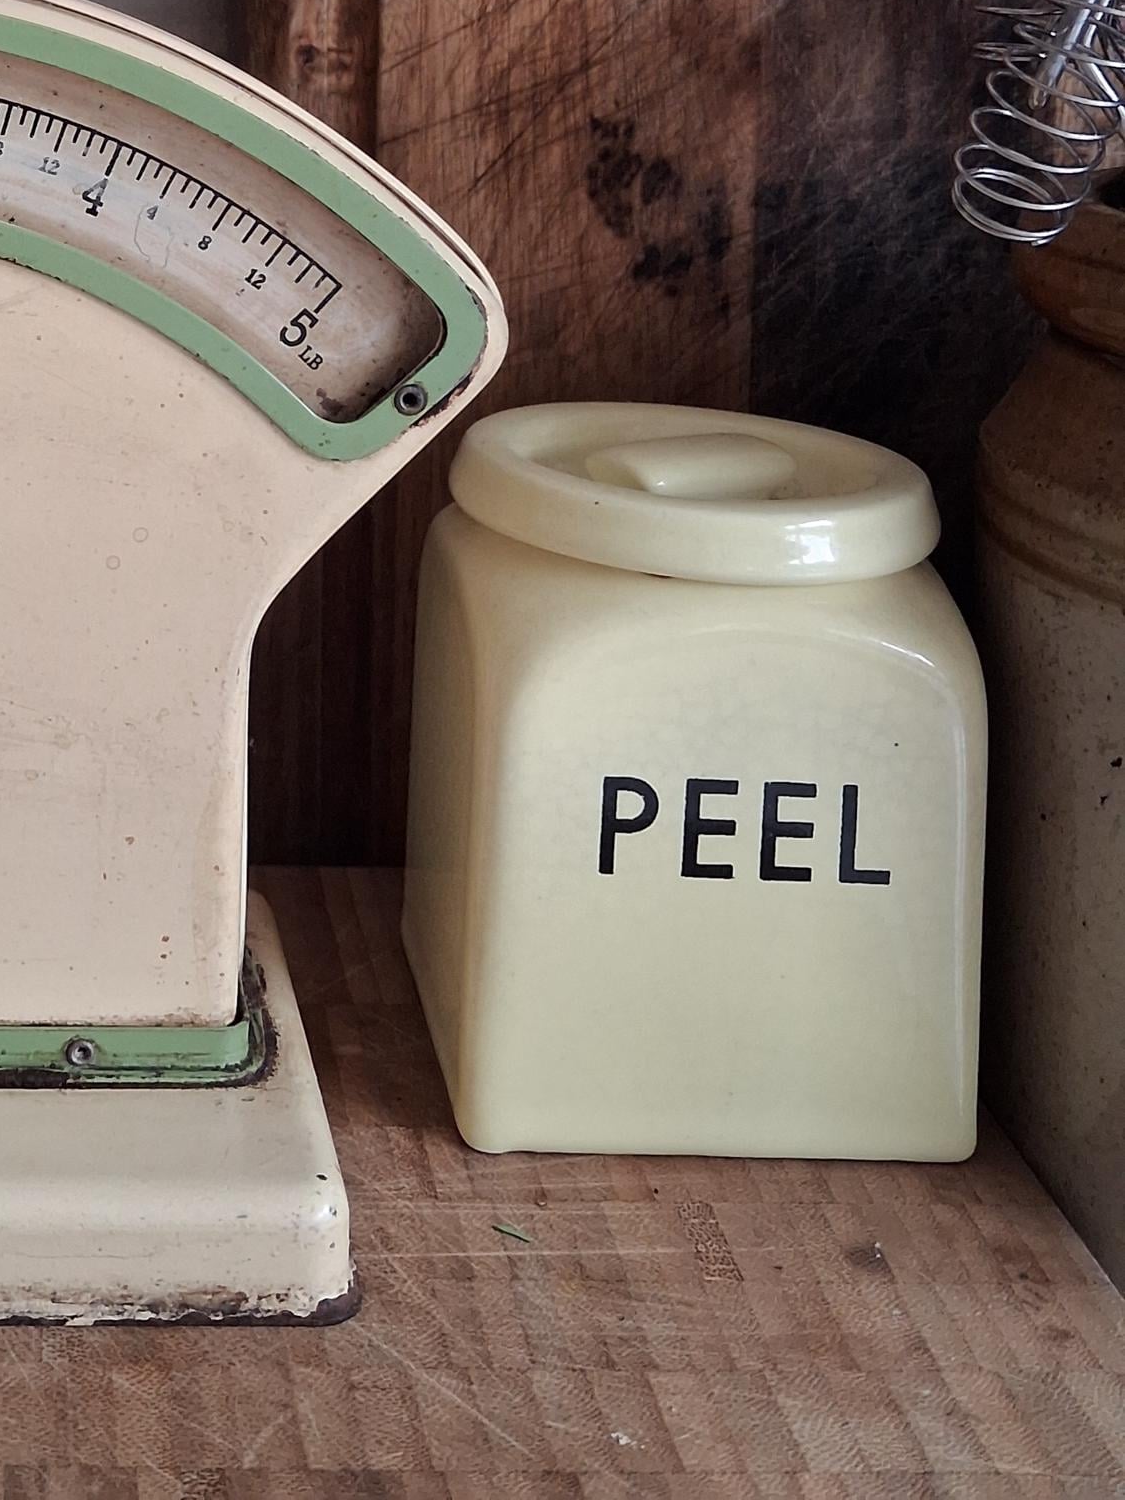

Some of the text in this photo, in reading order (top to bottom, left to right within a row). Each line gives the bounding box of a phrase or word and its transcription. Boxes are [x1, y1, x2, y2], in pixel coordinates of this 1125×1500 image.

[38, 157, 61, 175] 12
[81, 176, 111, 217] 4
[145, 204, 160, 221] 4
[197, 234, 213, 251] 8
[244, 267, 268, 290] 12
[278, 308, 319, 347] 5
[297, 344, 325, 371] LB
[599, 776, 891, 885] PEEL
